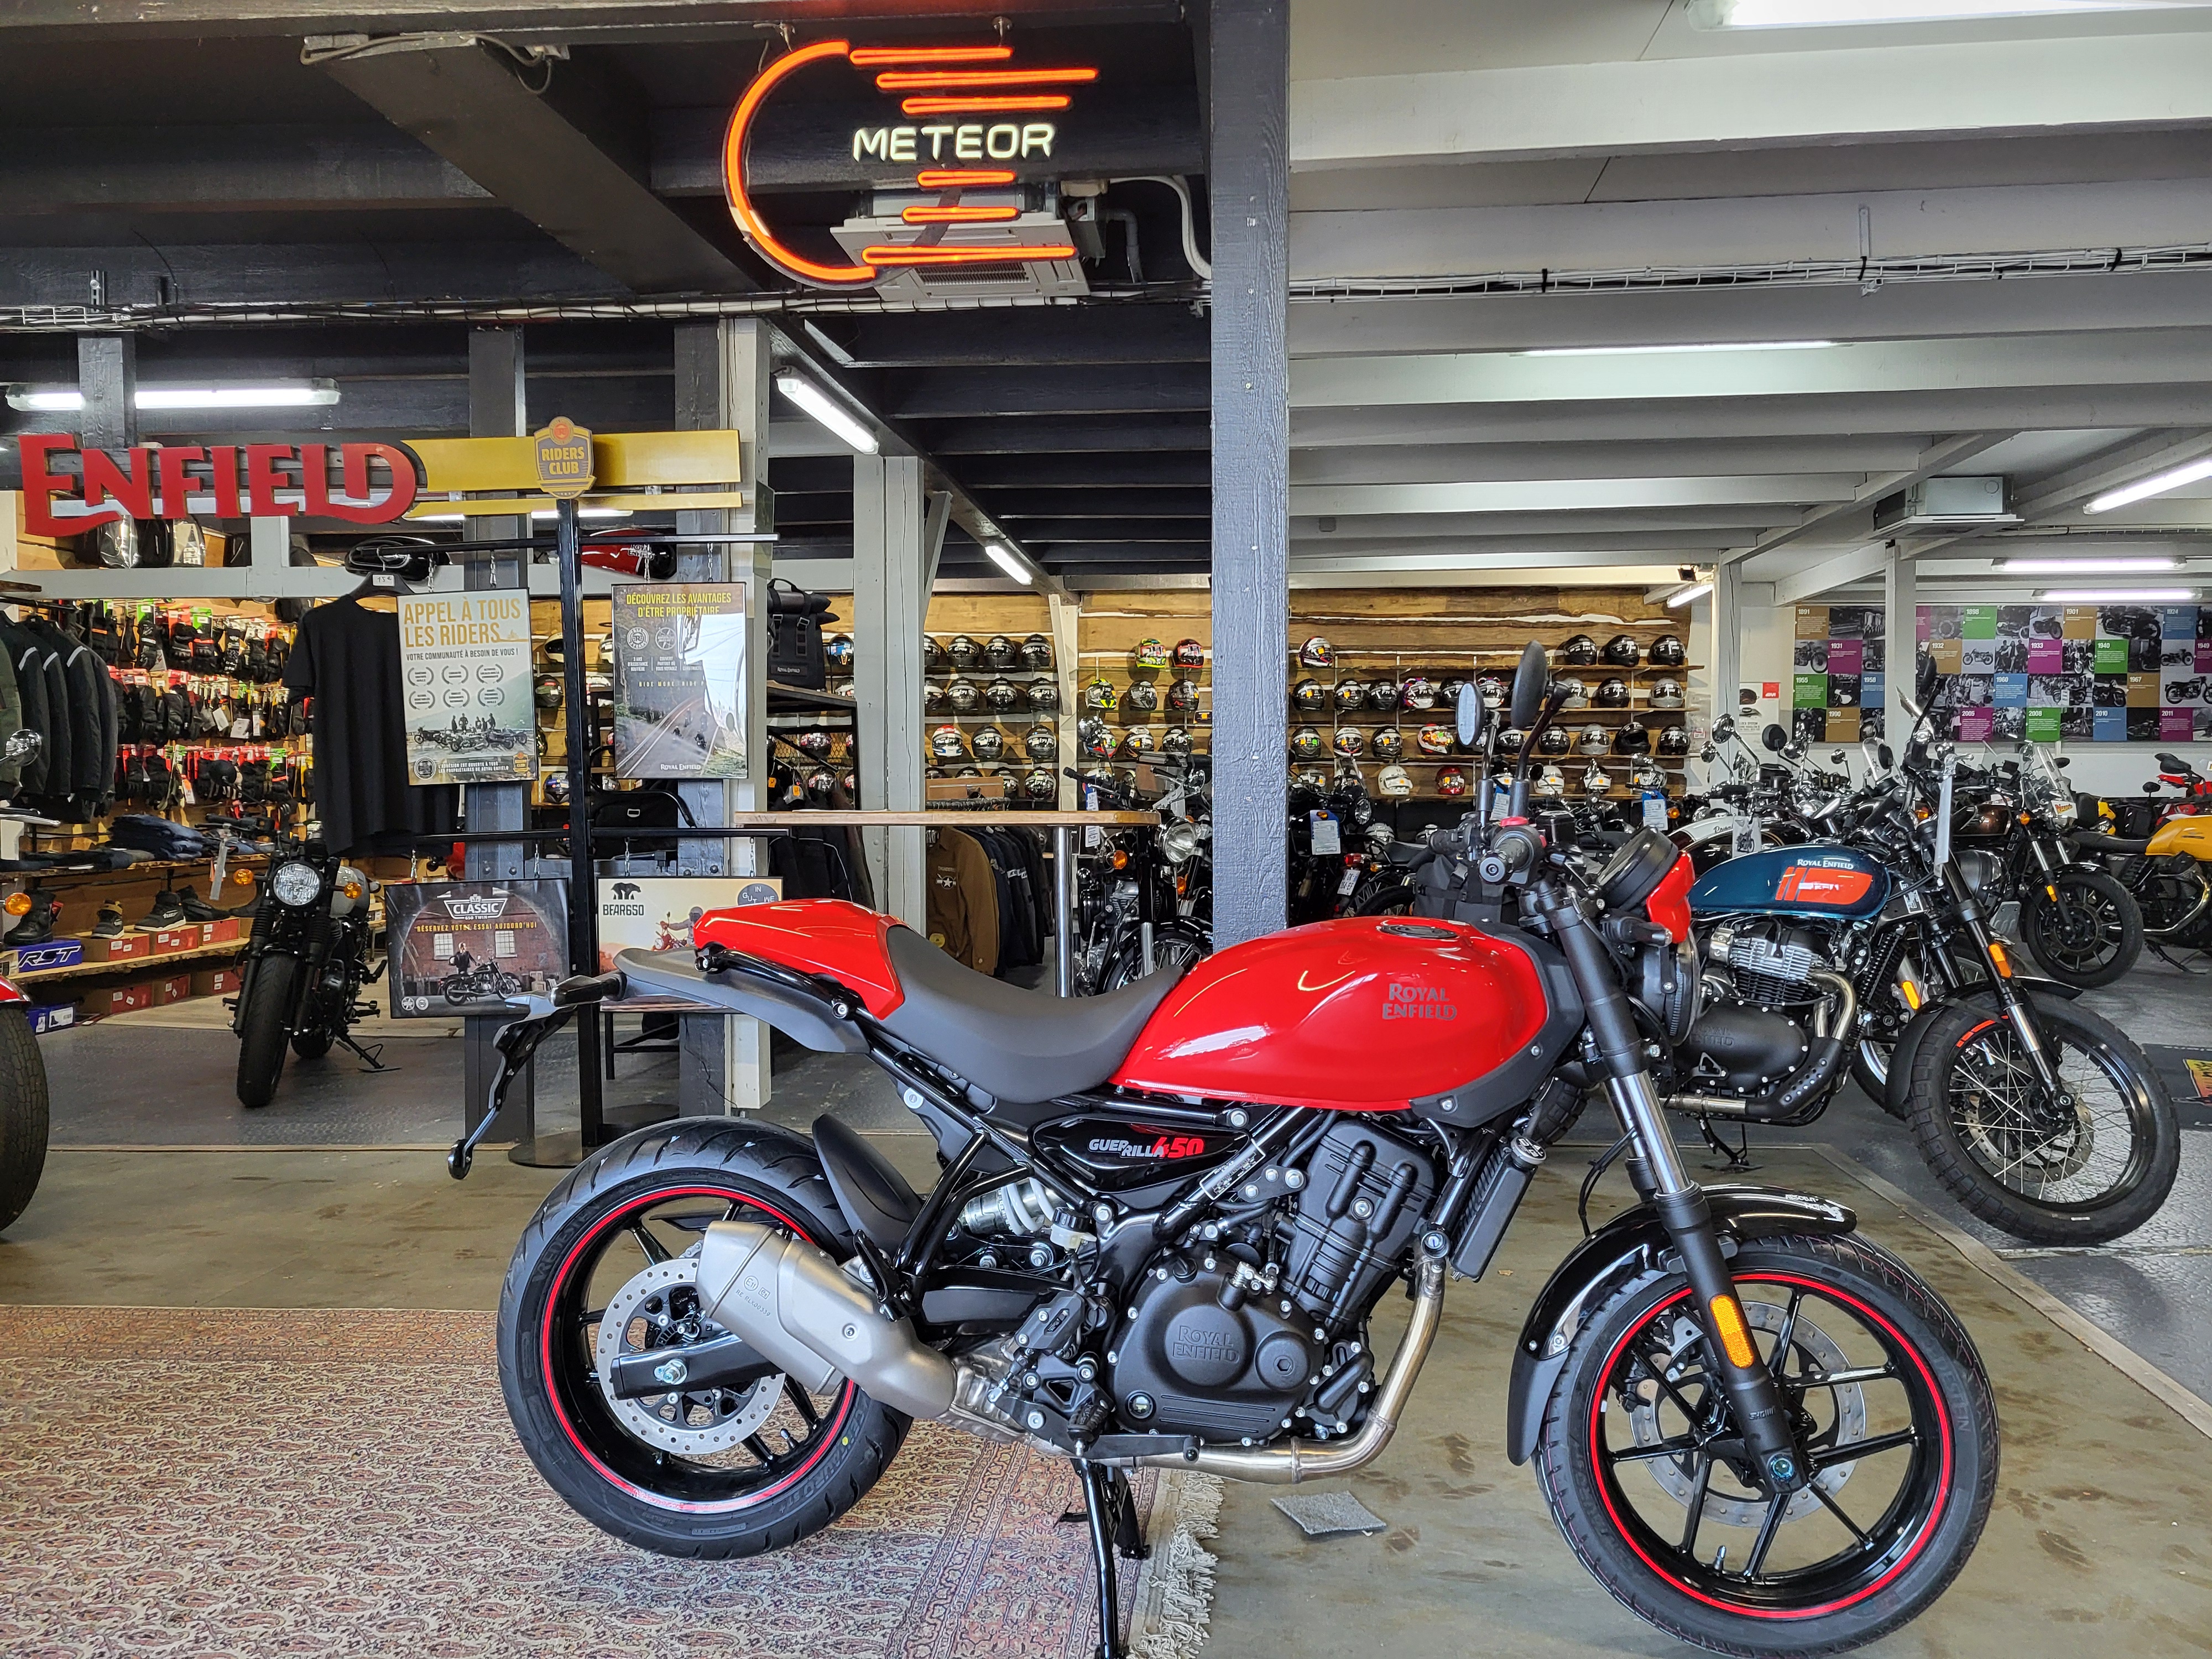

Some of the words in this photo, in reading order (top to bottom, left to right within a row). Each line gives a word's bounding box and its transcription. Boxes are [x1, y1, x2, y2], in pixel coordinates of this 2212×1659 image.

[853, 123, 1055, 163] METEOR
[541, 446, 585, 461] RIDERS
[549, 461, 579, 474] CLUB
[18, 433, 418, 537] ENFIELD
[627, 592, 670, 604] DÉCOUVREZ
[672, 594, 686, 604] LES
[688, 593, 731, 603] AVANTAGES
[404, 602, 456, 624] APPEL
[461, 596, 472, 621] À
[477, 598, 520, 620] TOUS
[638, 606, 664, 618] D'ÊTRE
[666, 604, 719, 617] PROPRIÉTAIRE
[405, 625, 435, 648] LES
[440, 623, 501, 646] RIDERS
[406, 653, 424, 661] VOTRE
[425, 649, 463, 660] COMMUNAUTÉ
[465, 649, 468, 658] À
[470, 649, 491, 658] BESOIN
[492, 648, 499, 656] DE
[500, 648, 515, 656] VOUS
[1823, 860, 1854, 870] ENFIELD
[453, 903, 499, 914] CLASSIC
[603, 904, 644, 916] BEAR650
[416, 924, 448, 932] RÉSERVEZ
[18, 946, 81, 968] RST
[1389, 983, 1450, 1002] ROYAL
[1383, 1003, 1457, 1021] ENFIELD
[1088, 1139, 1164, 1157] GUERRILLA
[1152, 1136, 1205, 1158] 450
[735, 1289, 744, 1297] RE
[1179, 1326, 1234, 1347] ROYAL
[1172, 1341, 1240, 1364] ENFIELD
